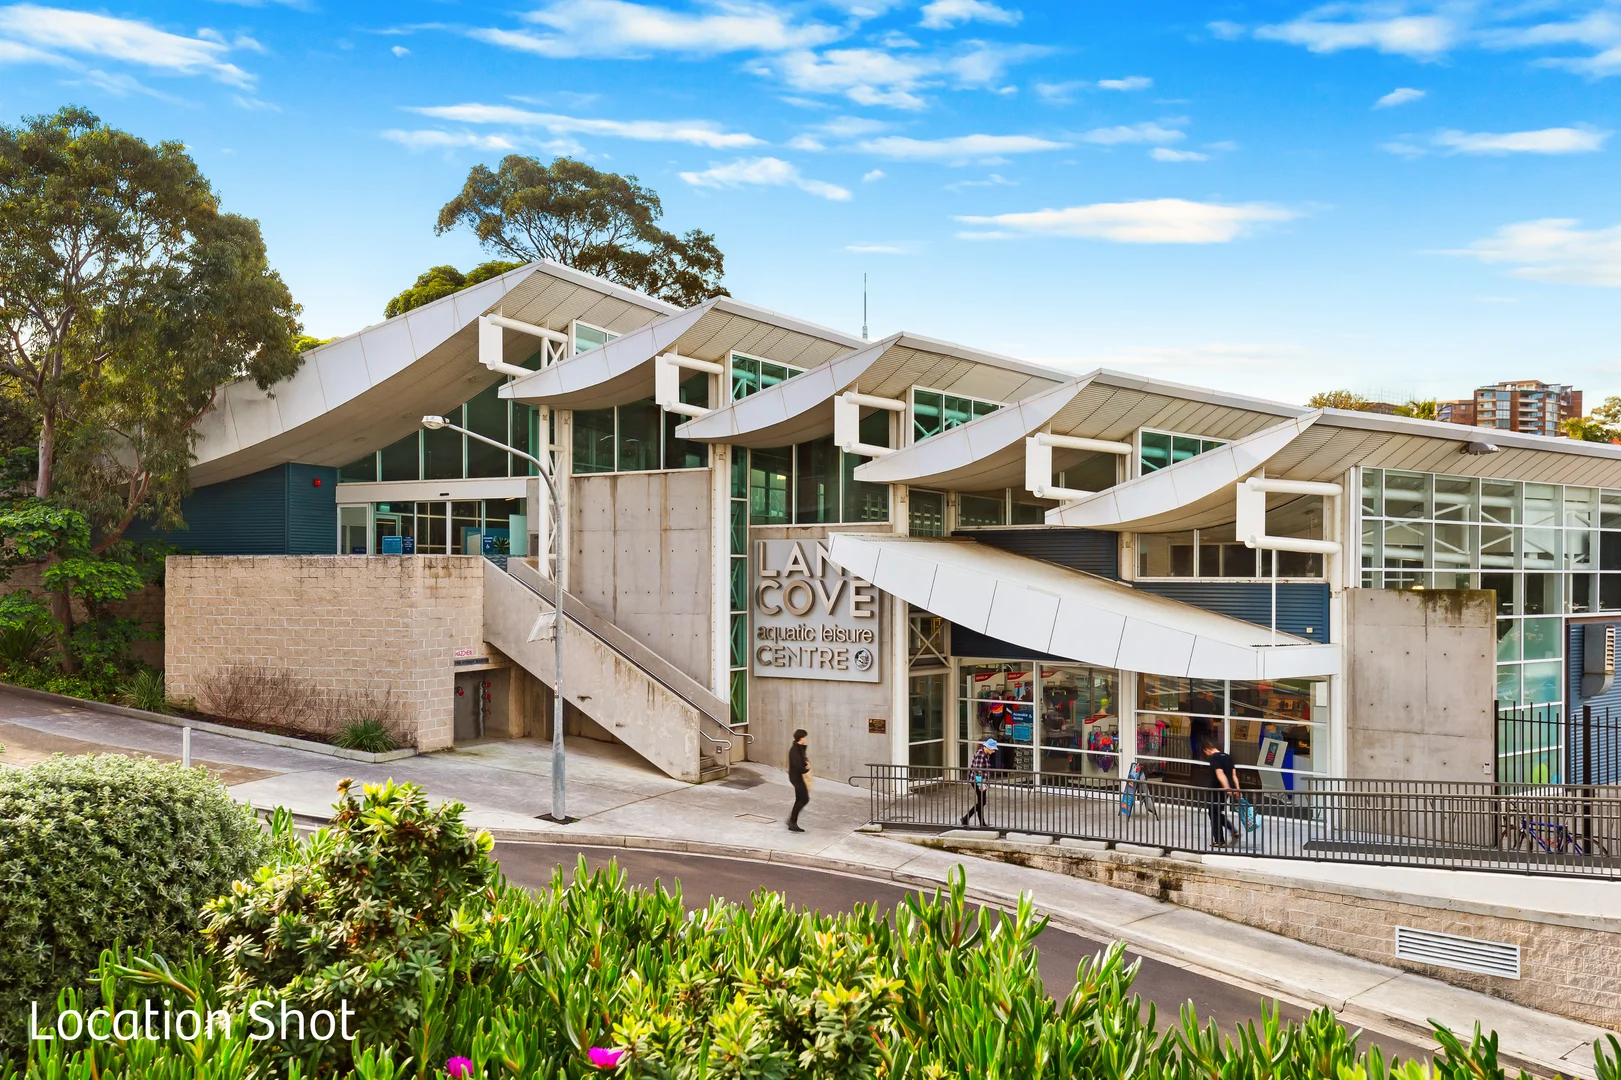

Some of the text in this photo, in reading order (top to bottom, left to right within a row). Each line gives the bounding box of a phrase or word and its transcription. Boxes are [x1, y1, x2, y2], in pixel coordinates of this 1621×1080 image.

[758, 541, 862, 578] LAN
[755, 580, 874, 617] COVE
[757, 623, 874, 644] aquatic leisure
[756, 645, 849, 670] CENTRE
